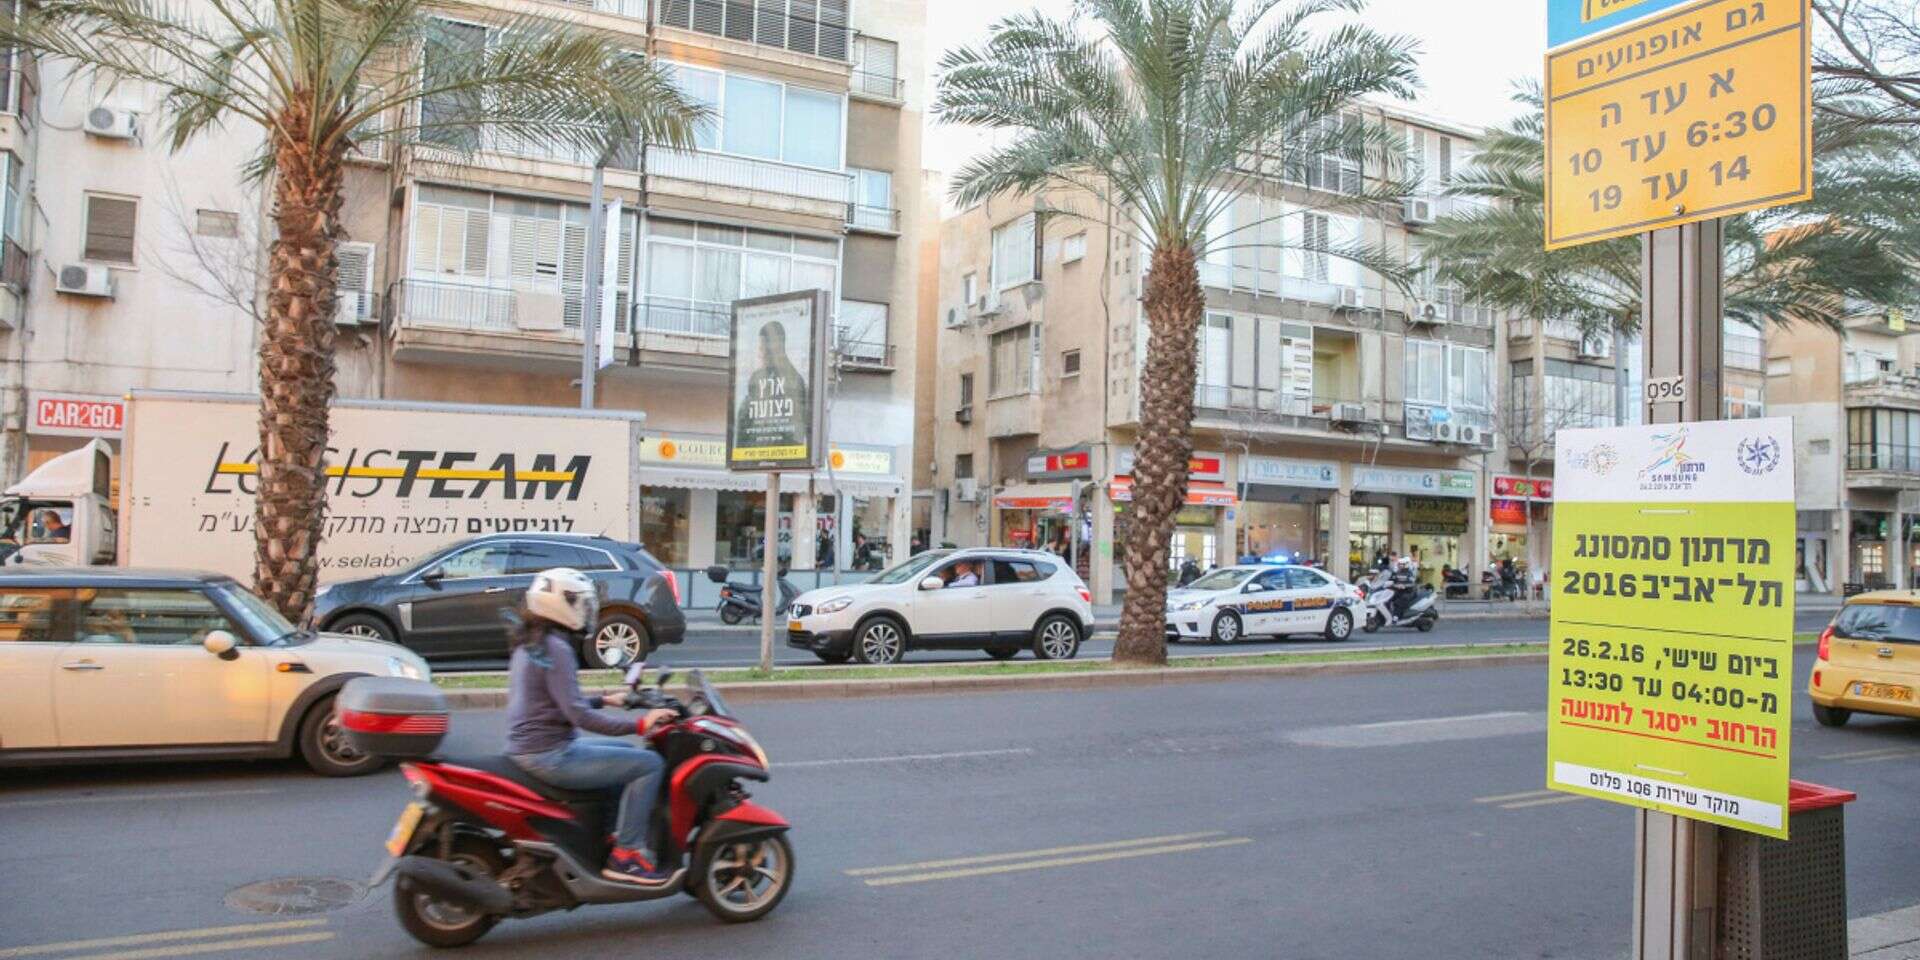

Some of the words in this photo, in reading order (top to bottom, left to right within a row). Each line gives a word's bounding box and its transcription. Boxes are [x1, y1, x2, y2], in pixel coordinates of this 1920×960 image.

[1725, 2, 1765, 32] גם
[1577, 21, 1702, 79] אופנועים
[1709, 68, 1735, 98] א
[1640, 82, 1688, 115] עד
[1601, 102, 1622, 128] ה
[1686, 103, 1777, 147] 6:30
[1621, 131, 1666, 163] עד
[1569, 148, 1602, 176] 10
[1709, 155, 1750, 186] 14
[1641, 169, 1688, 201] עד
[1589, 185, 1622, 212] 19
[759, 376, 785, 399] ארץ
[1648, 378, 1683, 398] 096
[749, 398, 793, 419] פצועה
[205, 442, 592, 500] LISTEAM
[1652, 474, 1697, 482] SAMSUNG
[200, 512, 254, 532] ע"מ
[393, 516, 458, 534] הפצה
[467, 515, 574, 534] לוגיסטים
[1574, 534, 1670, 561] סמסונג
[1680, 537, 1770, 567] מרתון
[1563, 571, 1637, 598] 2016
[1562, 638, 1645, 663] 26.2.16
[1655, 647, 1717, 671] שישי,
[1728, 654, 1779, 679] ביום
[1562, 668, 1623, 692] 13:30
[1632, 675, 1662, 697] עד
[1672, 681, 1777, 714] מ-04:00
[1561, 697, 1633, 725] לתנועה
[1641, 708, 1697, 732] ייסגר
[1706, 718, 1777, 749] הרחוב
[1590, 772, 1622, 790] פלוס
[1626, 779, 1651, 796] 106
[1656, 785, 1697, 806] שירות
[1702, 794, 1740, 815] מוקד
